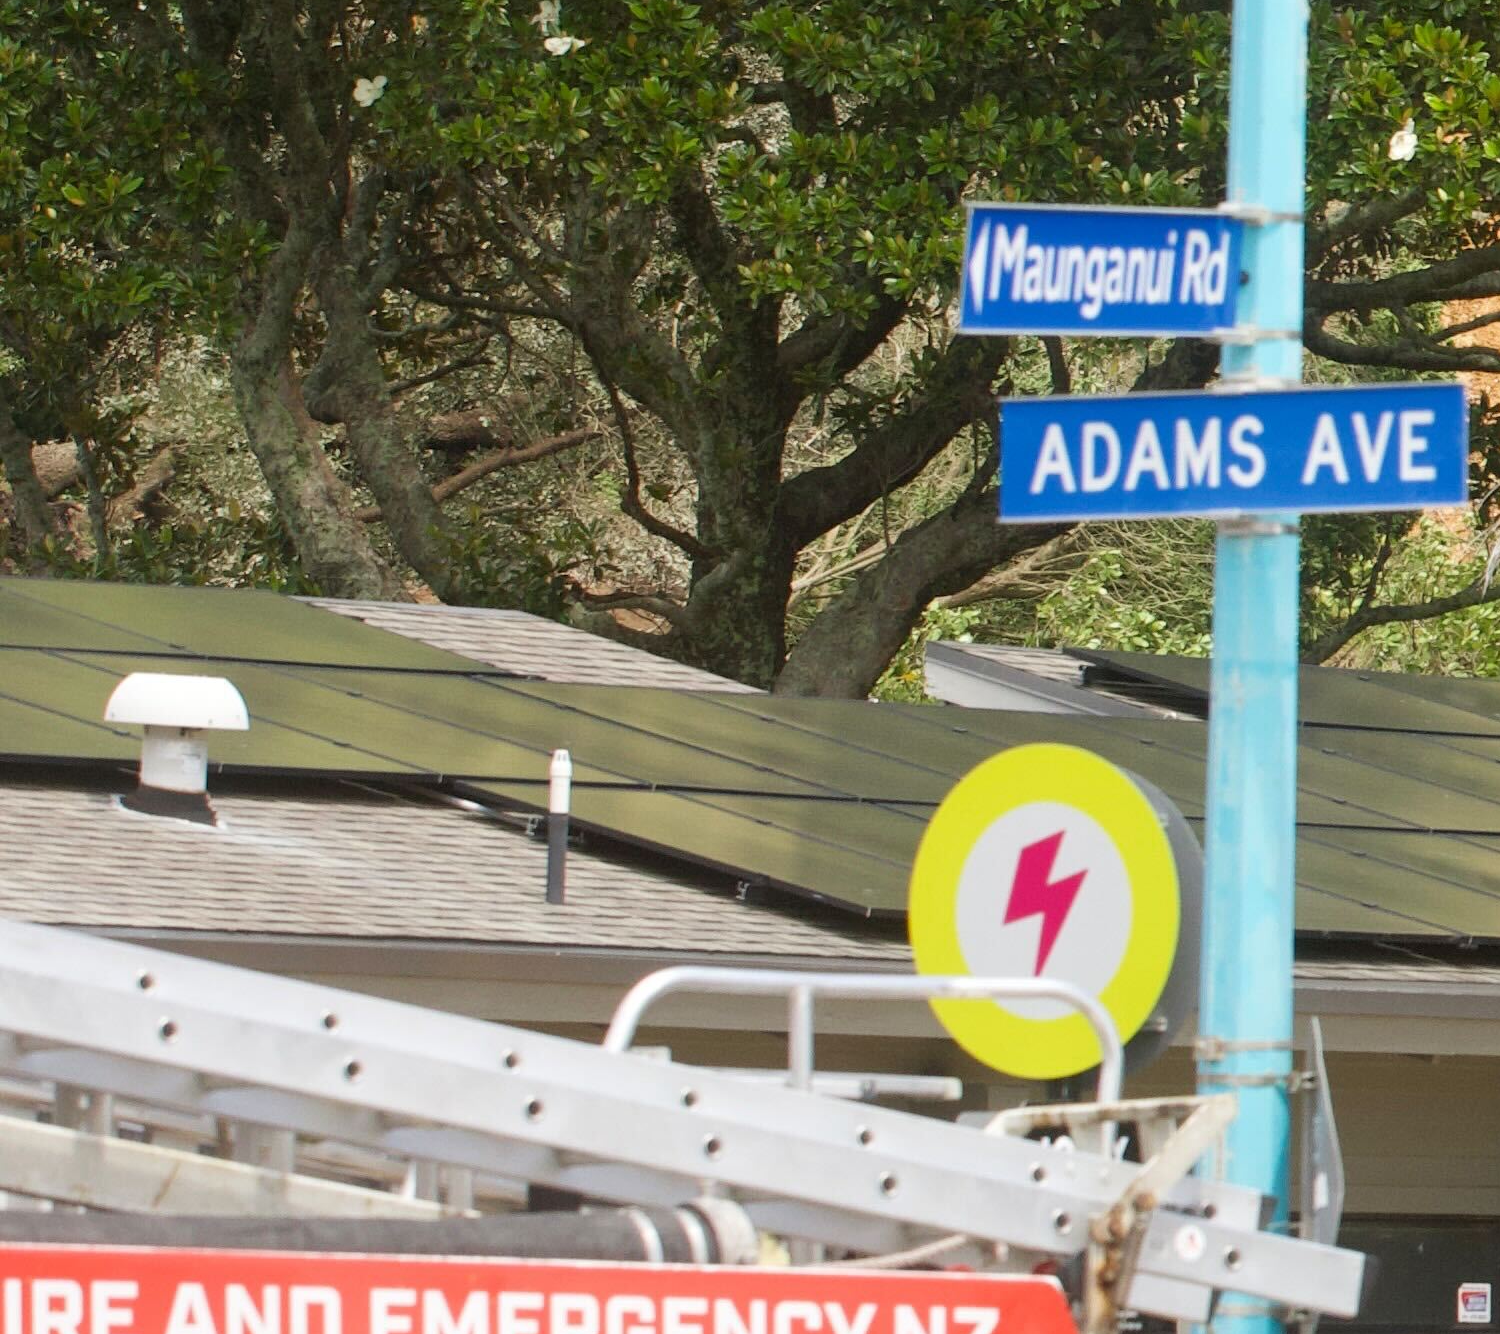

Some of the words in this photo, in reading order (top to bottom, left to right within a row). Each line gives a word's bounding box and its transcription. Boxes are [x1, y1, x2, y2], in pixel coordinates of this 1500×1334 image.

[988, 224, 1176, 320] Maunganui
[1180, 232, 1230, 306] Rd
[1030, 415, 1266, 496] ADAMS
[1302, 408, 1436, 486] AVE
